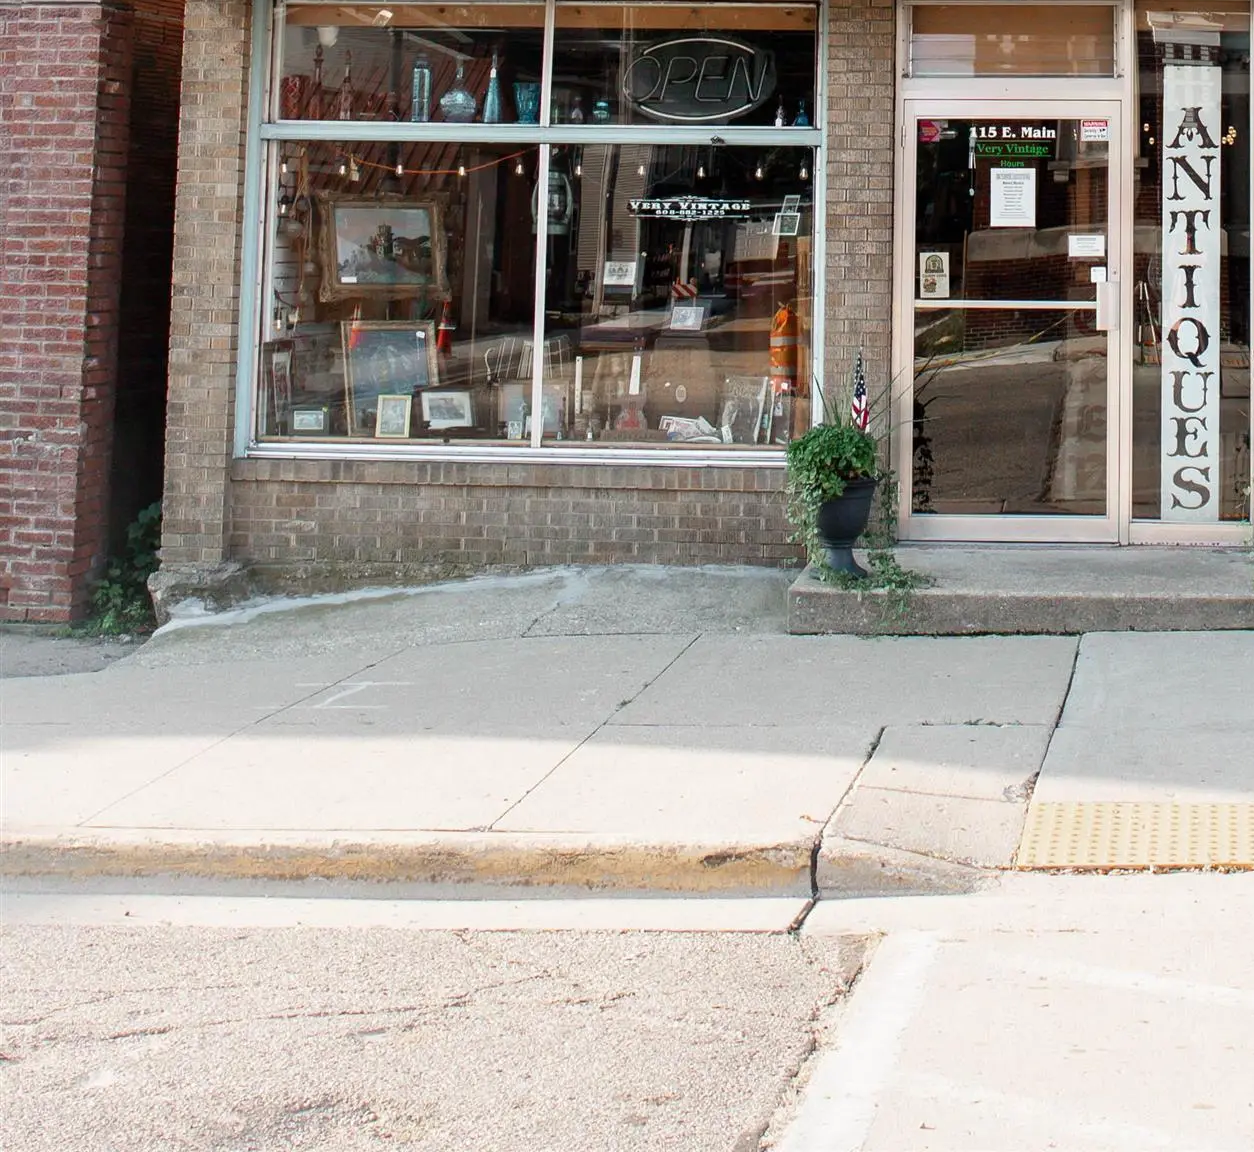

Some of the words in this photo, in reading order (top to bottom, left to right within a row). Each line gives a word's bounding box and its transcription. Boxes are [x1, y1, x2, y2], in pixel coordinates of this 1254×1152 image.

[623, 56, 768, 102] OPEN
[969, 126, 997, 138] 115
[1002, 126, 1017, 138] E.
[1021, 126, 1056, 138] Main
[976, 143, 1003, 156] Very
[1005, 143, 1049, 156] Vintage
[1000, 159, 1025, 167] Hours
[629, 201, 672, 210] VERY
[678, 201, 751, 211] VINTAGE
[1166, 106, 1217, 510] ANTIQUES
